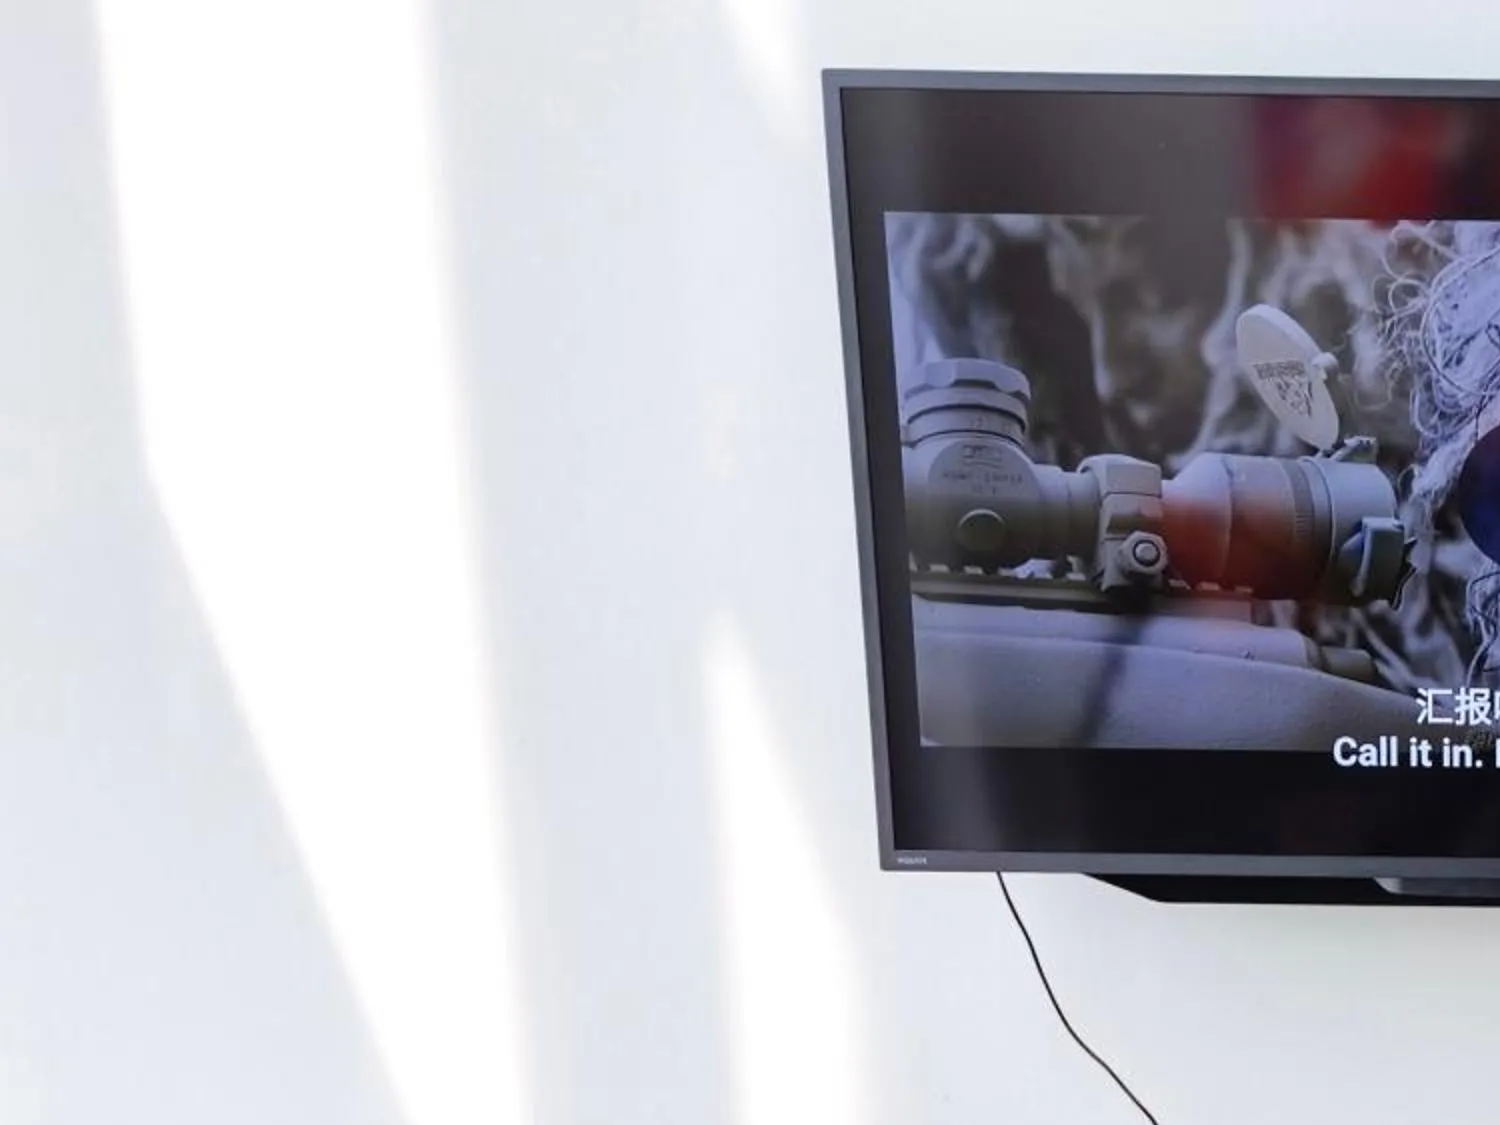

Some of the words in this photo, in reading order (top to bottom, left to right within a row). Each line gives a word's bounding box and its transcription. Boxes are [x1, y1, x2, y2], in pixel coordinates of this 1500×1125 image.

[1332, 735, 1399, 768] Call
[1408, 735, 1433, 768] it
[1442, 736, 1484, 768] in.
